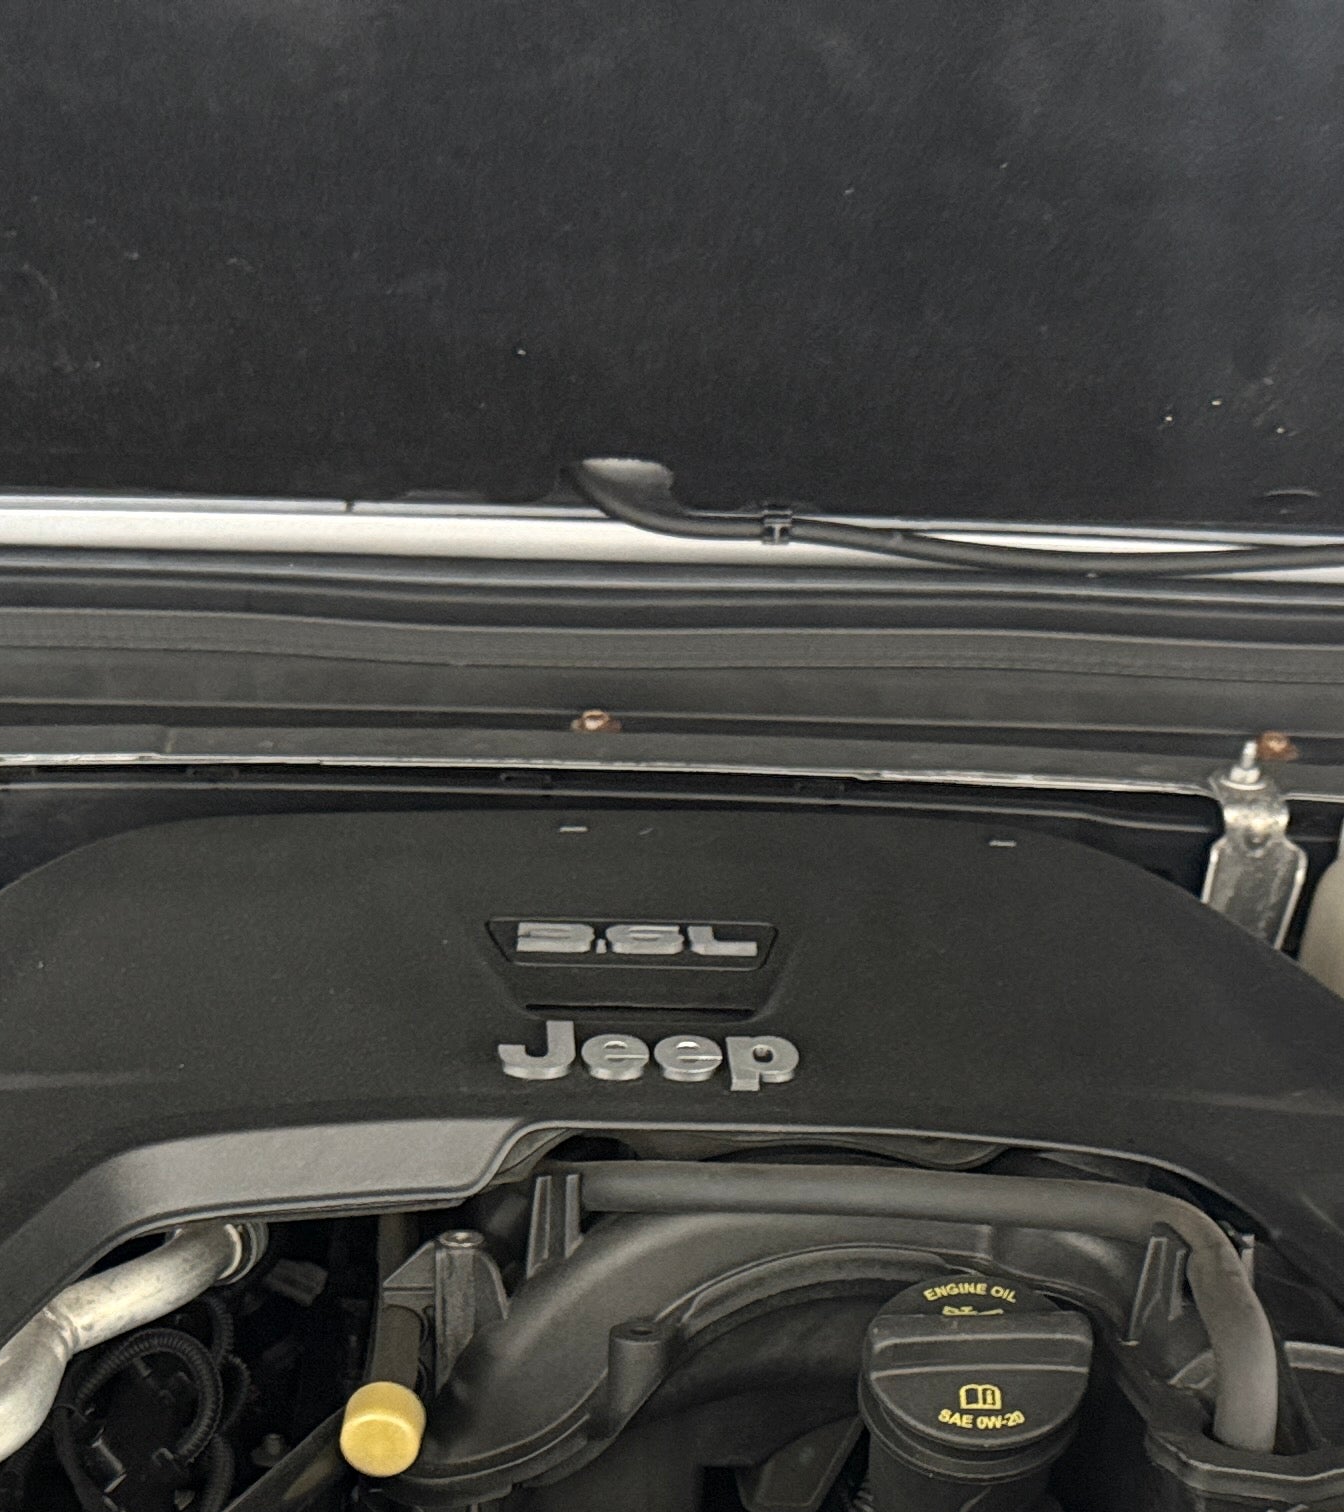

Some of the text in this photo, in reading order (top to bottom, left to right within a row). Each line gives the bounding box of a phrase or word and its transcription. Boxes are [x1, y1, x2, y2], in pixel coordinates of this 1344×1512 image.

[516, 921, 759, 958] 3.6L
[496, 1020, 800, 1092] Jeep
[922, 1282, 1018, 1304] ENGINE OIL
[937, 1408, 1026, 1430] SAE 0W-20
